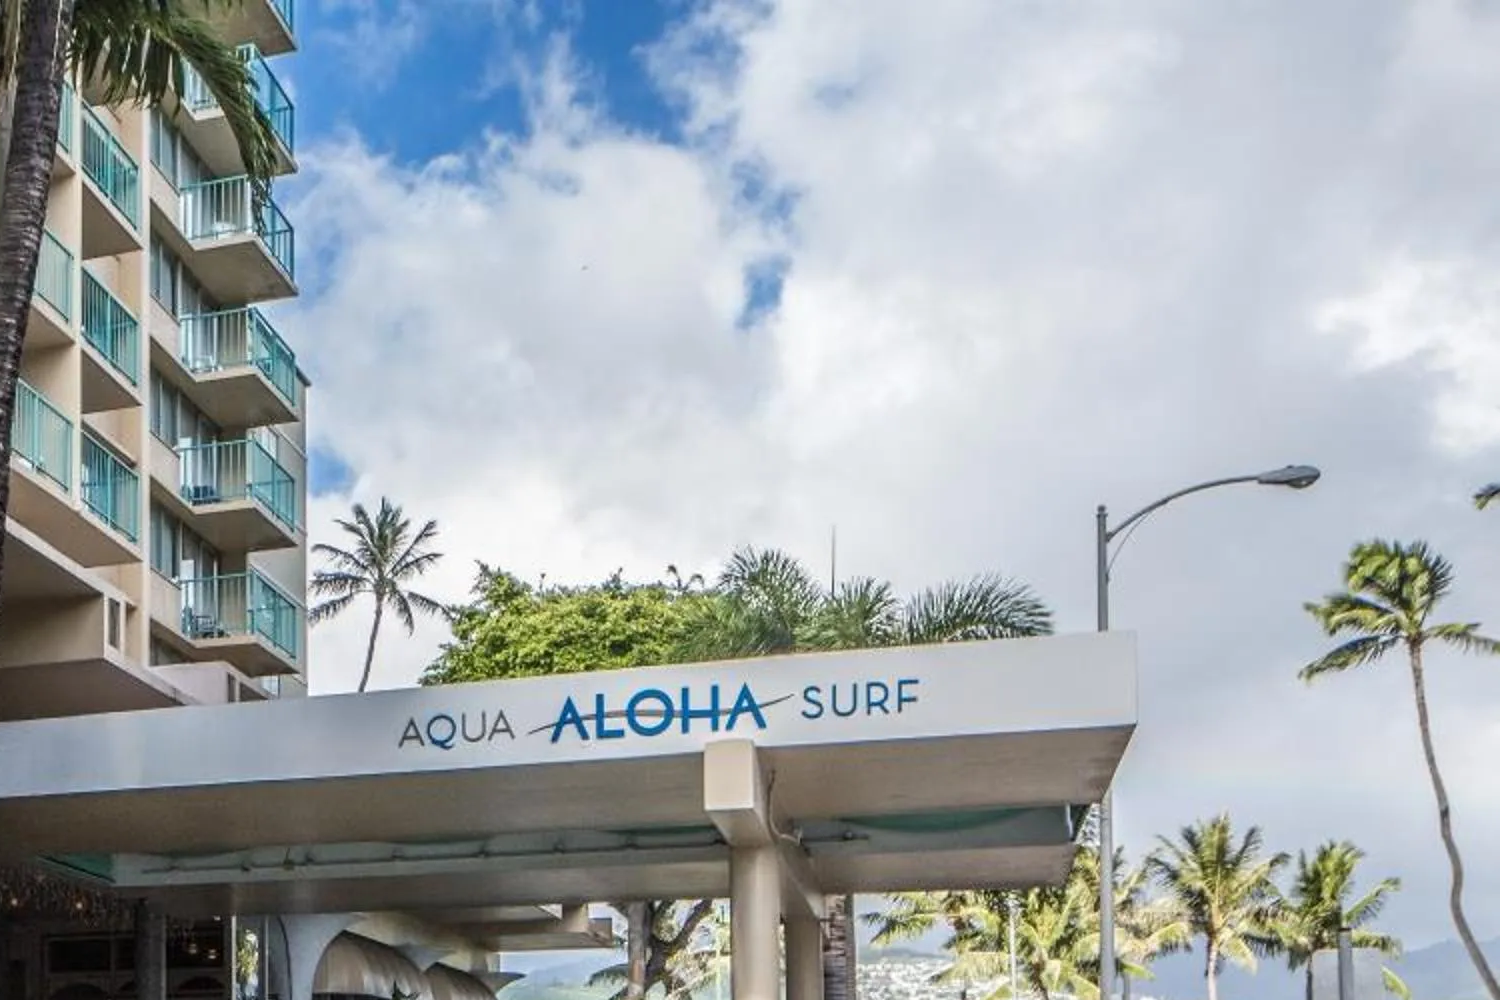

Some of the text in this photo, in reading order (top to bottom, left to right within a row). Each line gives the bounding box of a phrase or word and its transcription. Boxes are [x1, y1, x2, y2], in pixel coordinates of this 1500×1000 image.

[398, 678, 921, 750] AQUA ALOHA SURF
